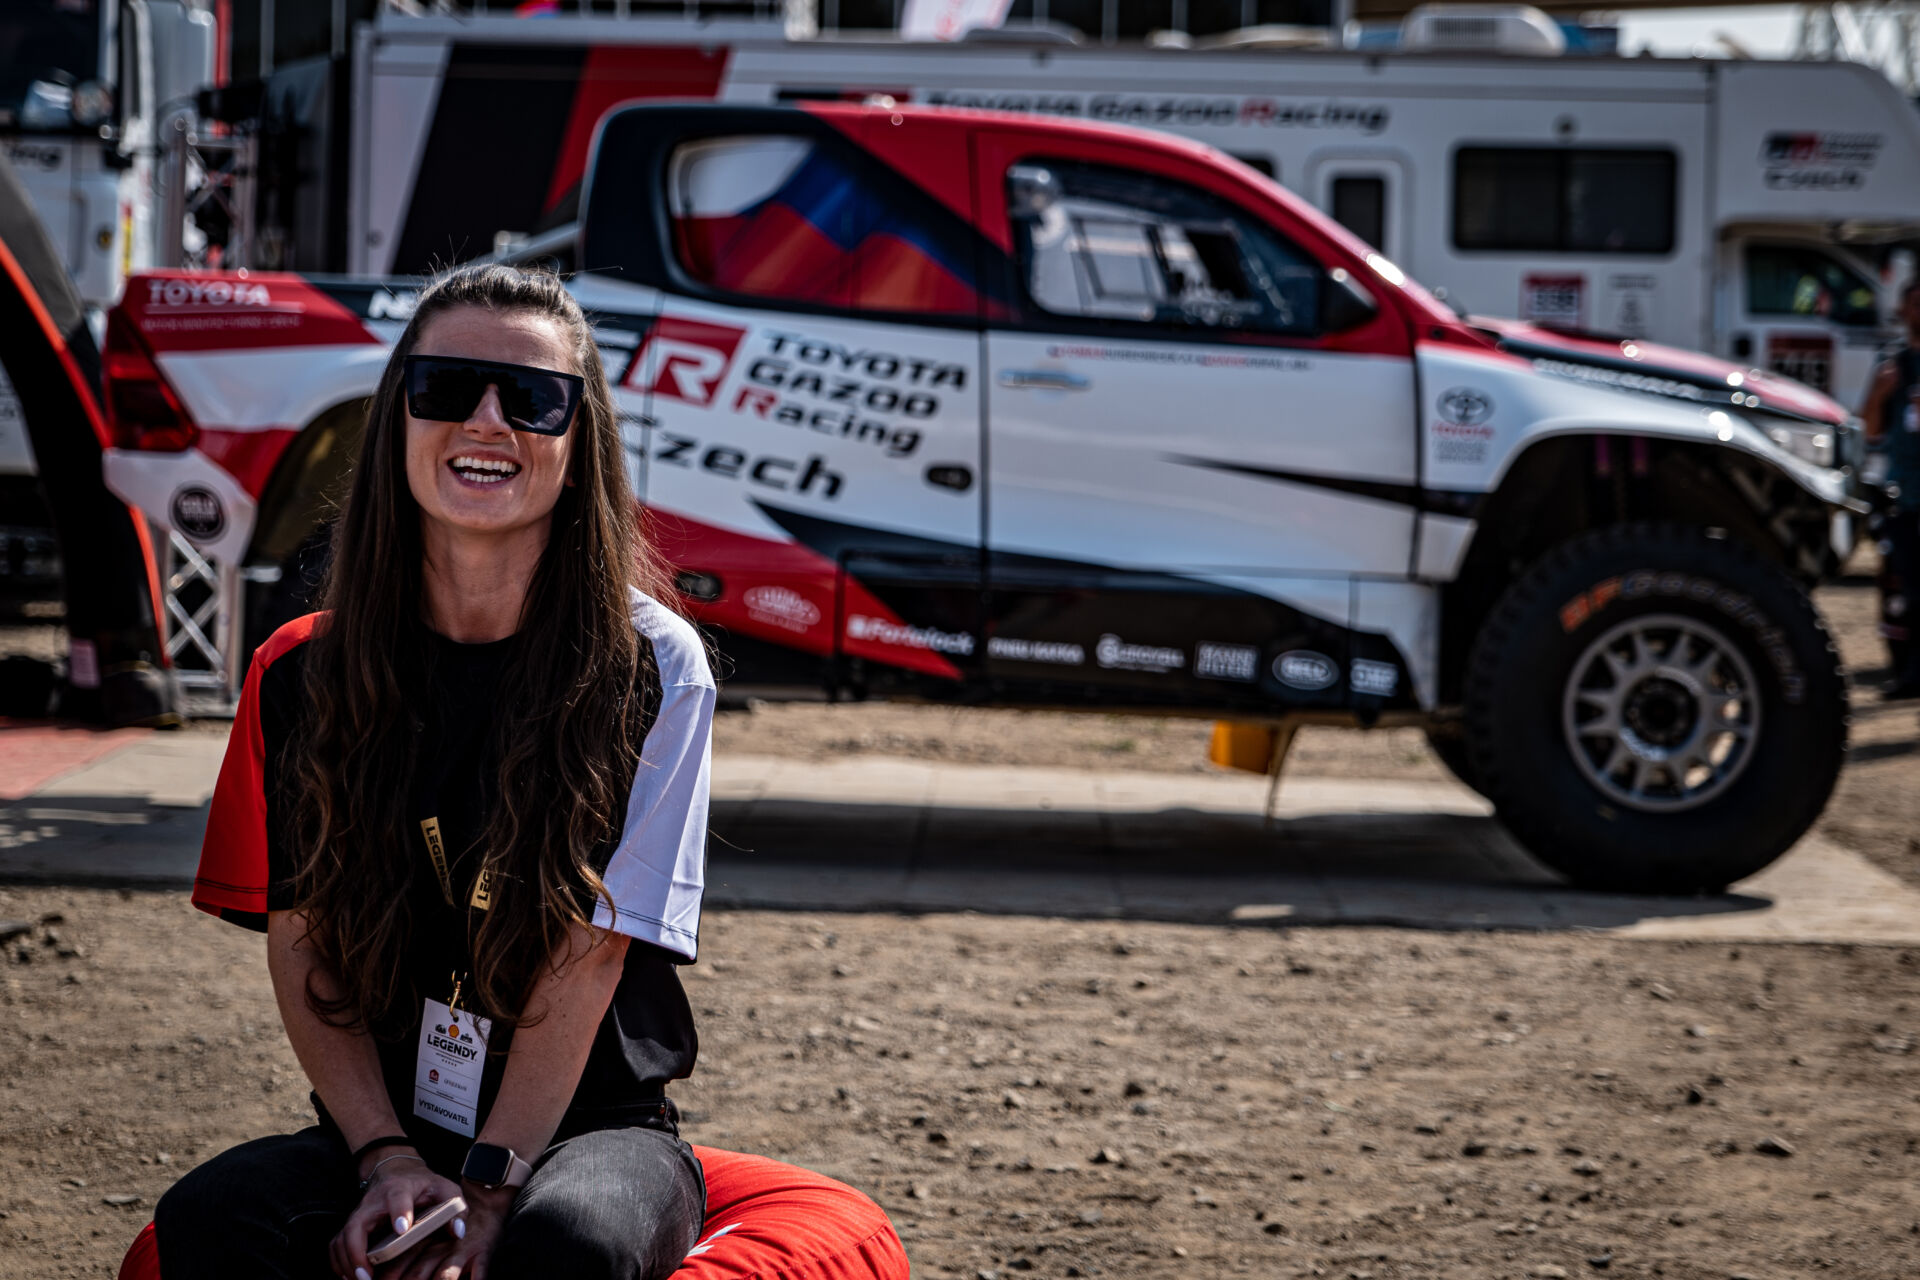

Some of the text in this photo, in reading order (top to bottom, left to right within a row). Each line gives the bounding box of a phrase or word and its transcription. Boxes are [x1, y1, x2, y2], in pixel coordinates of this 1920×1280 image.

[1239, 97, 1390, 136] Racing
[148, 277, 271, 307] TOYOTA
[762, 327, 970, 392] TOYOTA
[747, 356, 940, 421] GAZOO
[730, 386, 925, 459] Racing
[614, 412, 846, 500] Czech
[426, 1033, 478, 1061] LEGENDY
[418, 1098, 470, 1126] VYSTAVOVATEL
